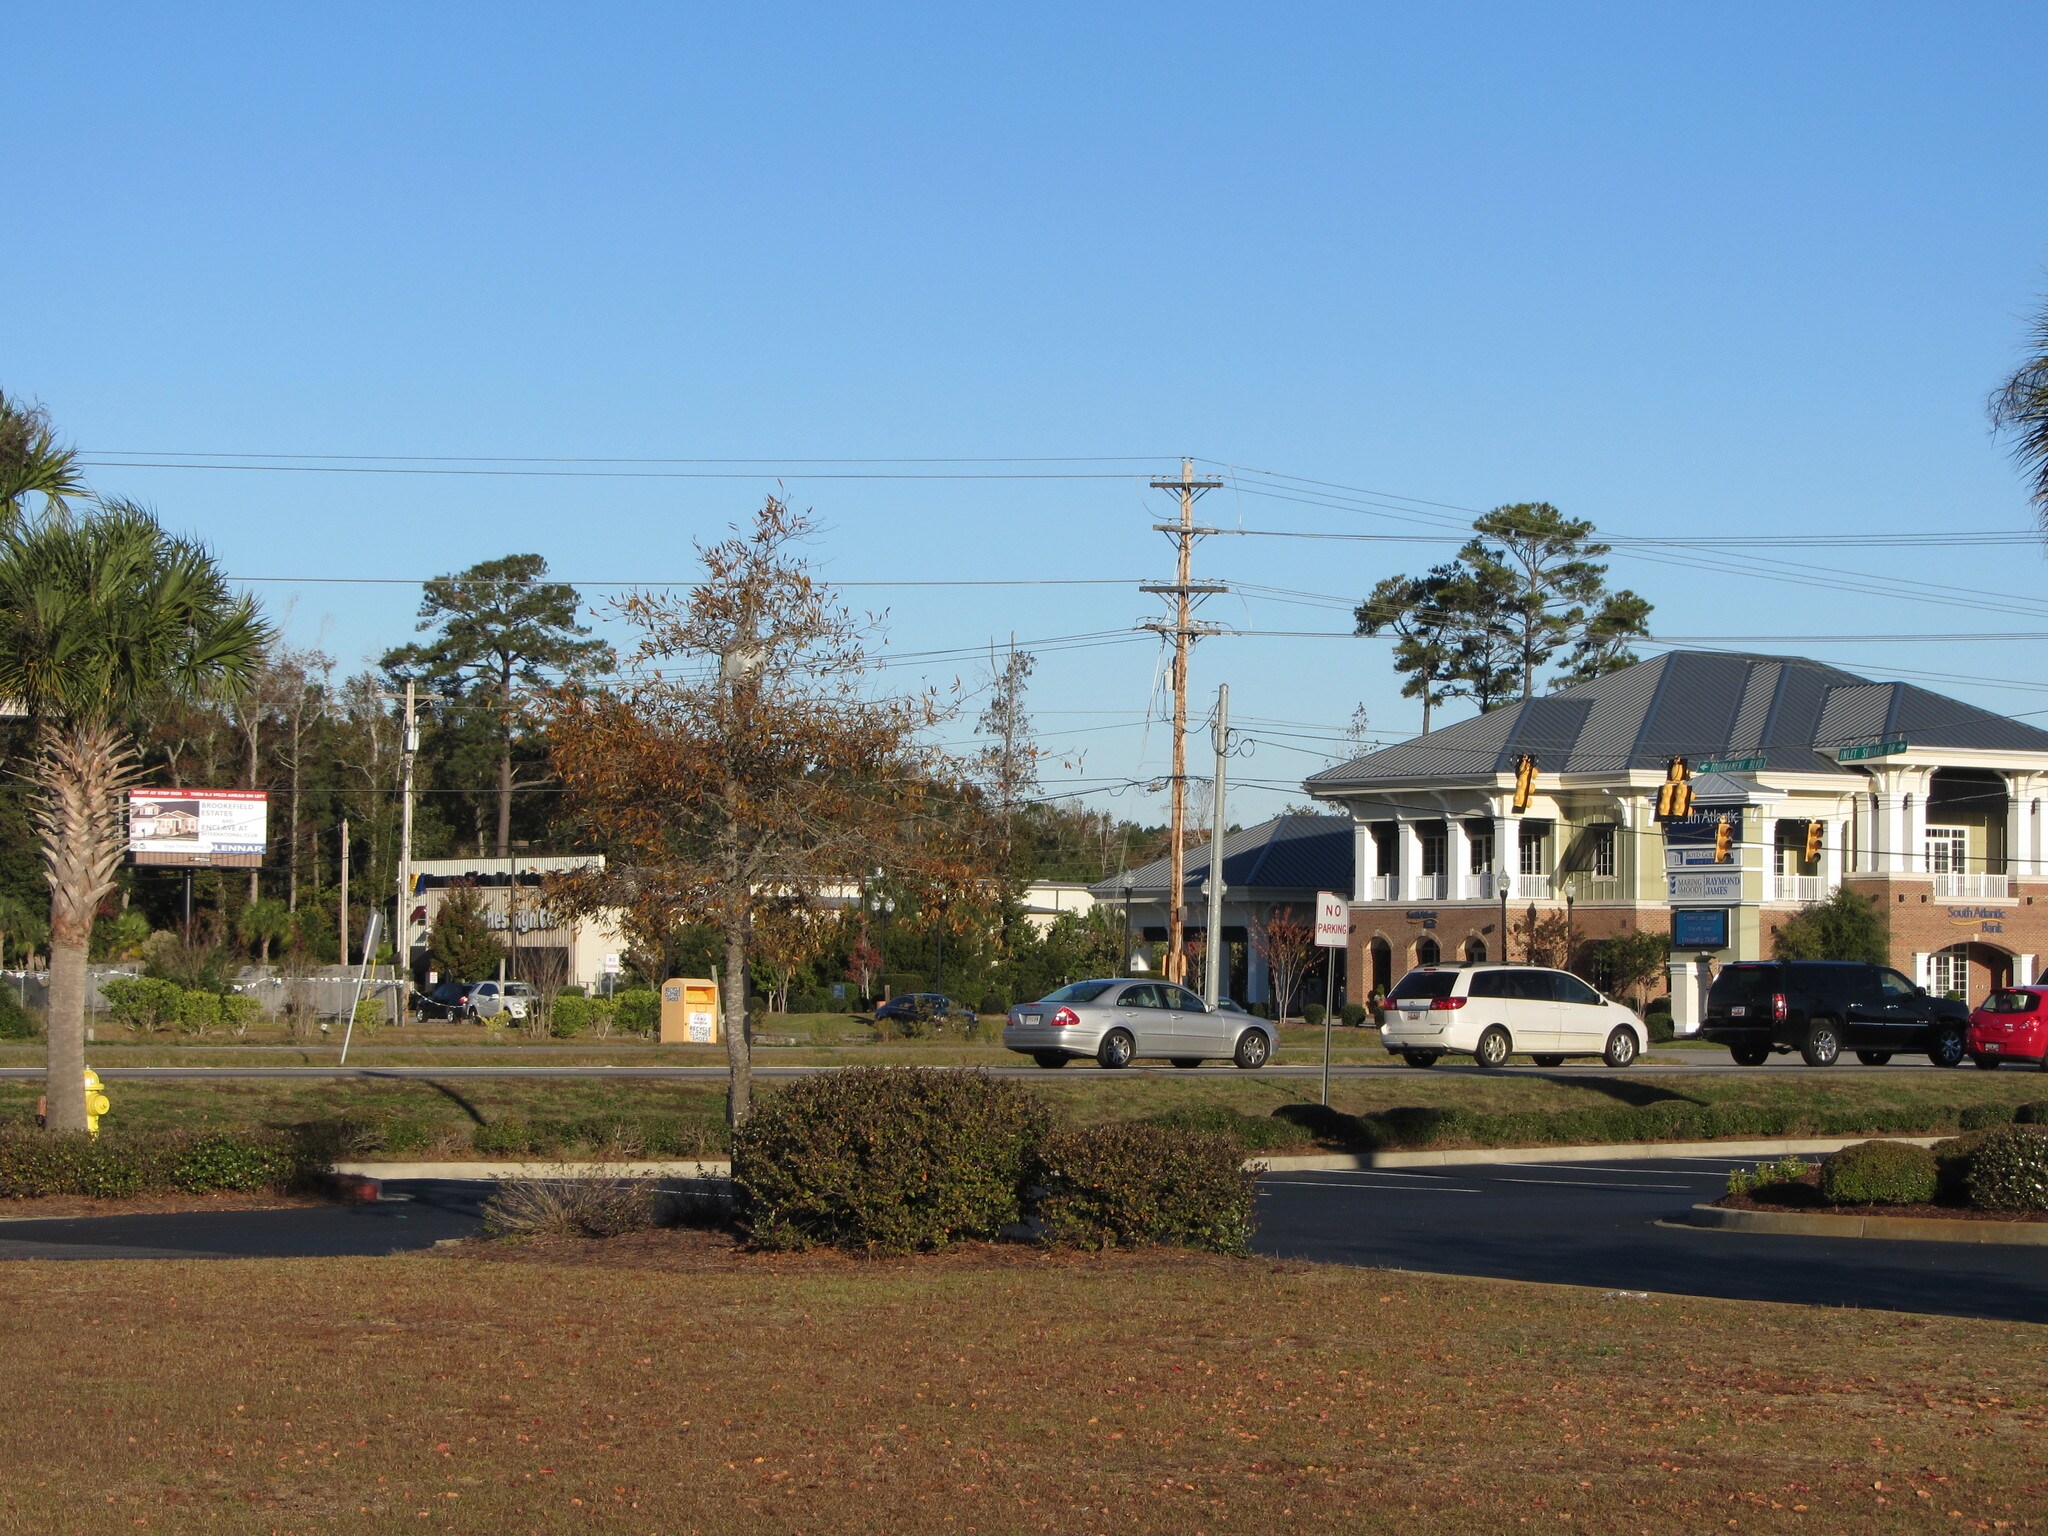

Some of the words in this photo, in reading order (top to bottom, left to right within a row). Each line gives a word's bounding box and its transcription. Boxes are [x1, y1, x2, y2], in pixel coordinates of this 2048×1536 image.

[1840, 749, 1858, 760] INLET
[1861, 745, 1884, 759] SQUARE
[1887, 743, 1896, 754] DR
[1710, 761, 1744, 773] TOURNAMENT
[1748, 759, 1764, 770] BLVD
[201, 802, 254, 810] BROOKEFIELD
[214, 844, 264, 853] LENNAR
[1705, 876, 1740, 886] RAYMOND
[1680, 886, 1703, 894] MOODY
[1705, 886, 1728, 895] JAMES
[1325, 904, 1342, 917] NO
[1947, 906, 1973, 918] South
[1974, 907, 2006, 919] Atlantic
[1317, 923, 1347, 934] PARKING
[1981, 921, 2003, 933] Bank
